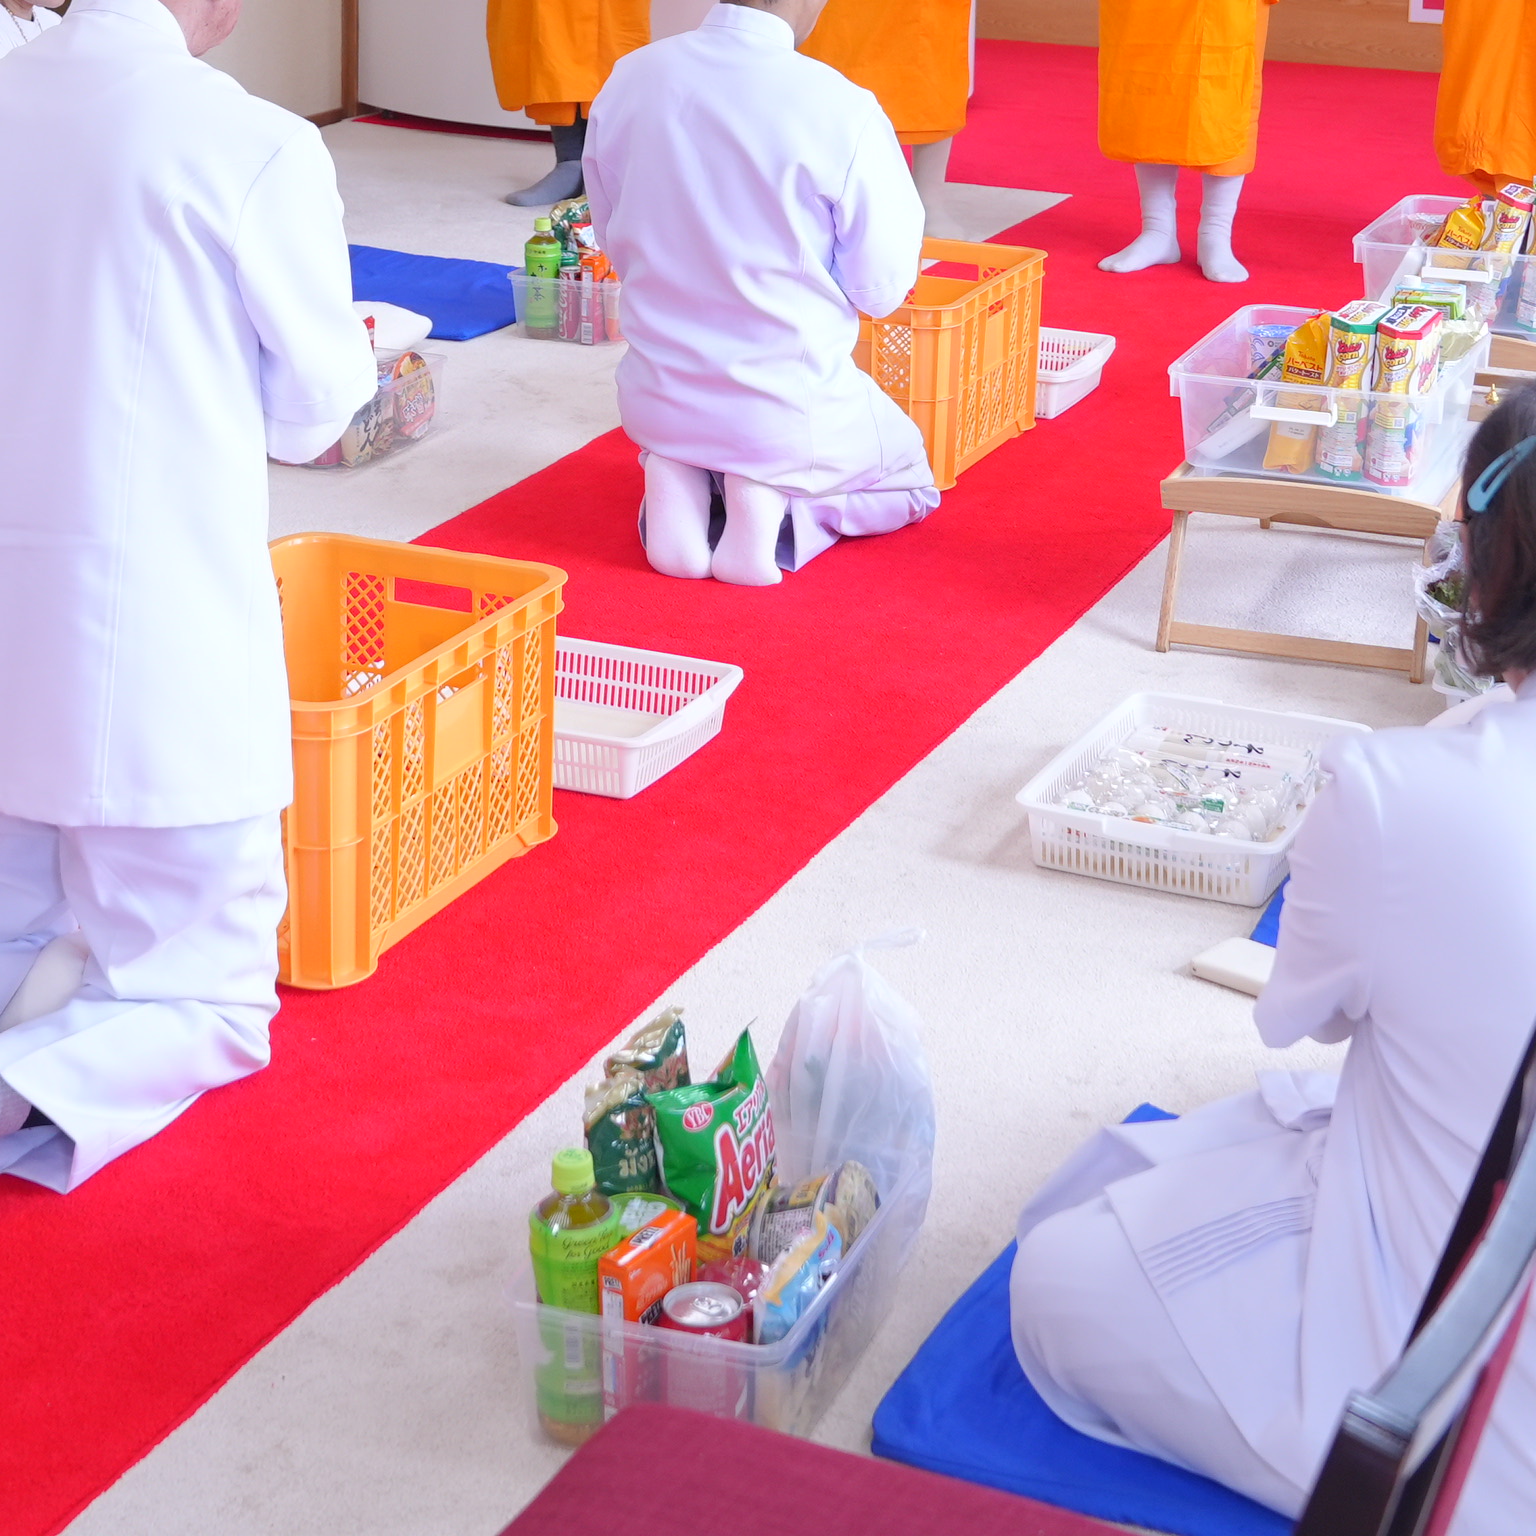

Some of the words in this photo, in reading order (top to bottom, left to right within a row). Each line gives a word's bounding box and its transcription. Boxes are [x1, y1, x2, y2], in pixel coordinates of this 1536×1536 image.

[1286, 356, 1324, 371] ハーベスト
[685, 1102, 711, 1129] YBC
